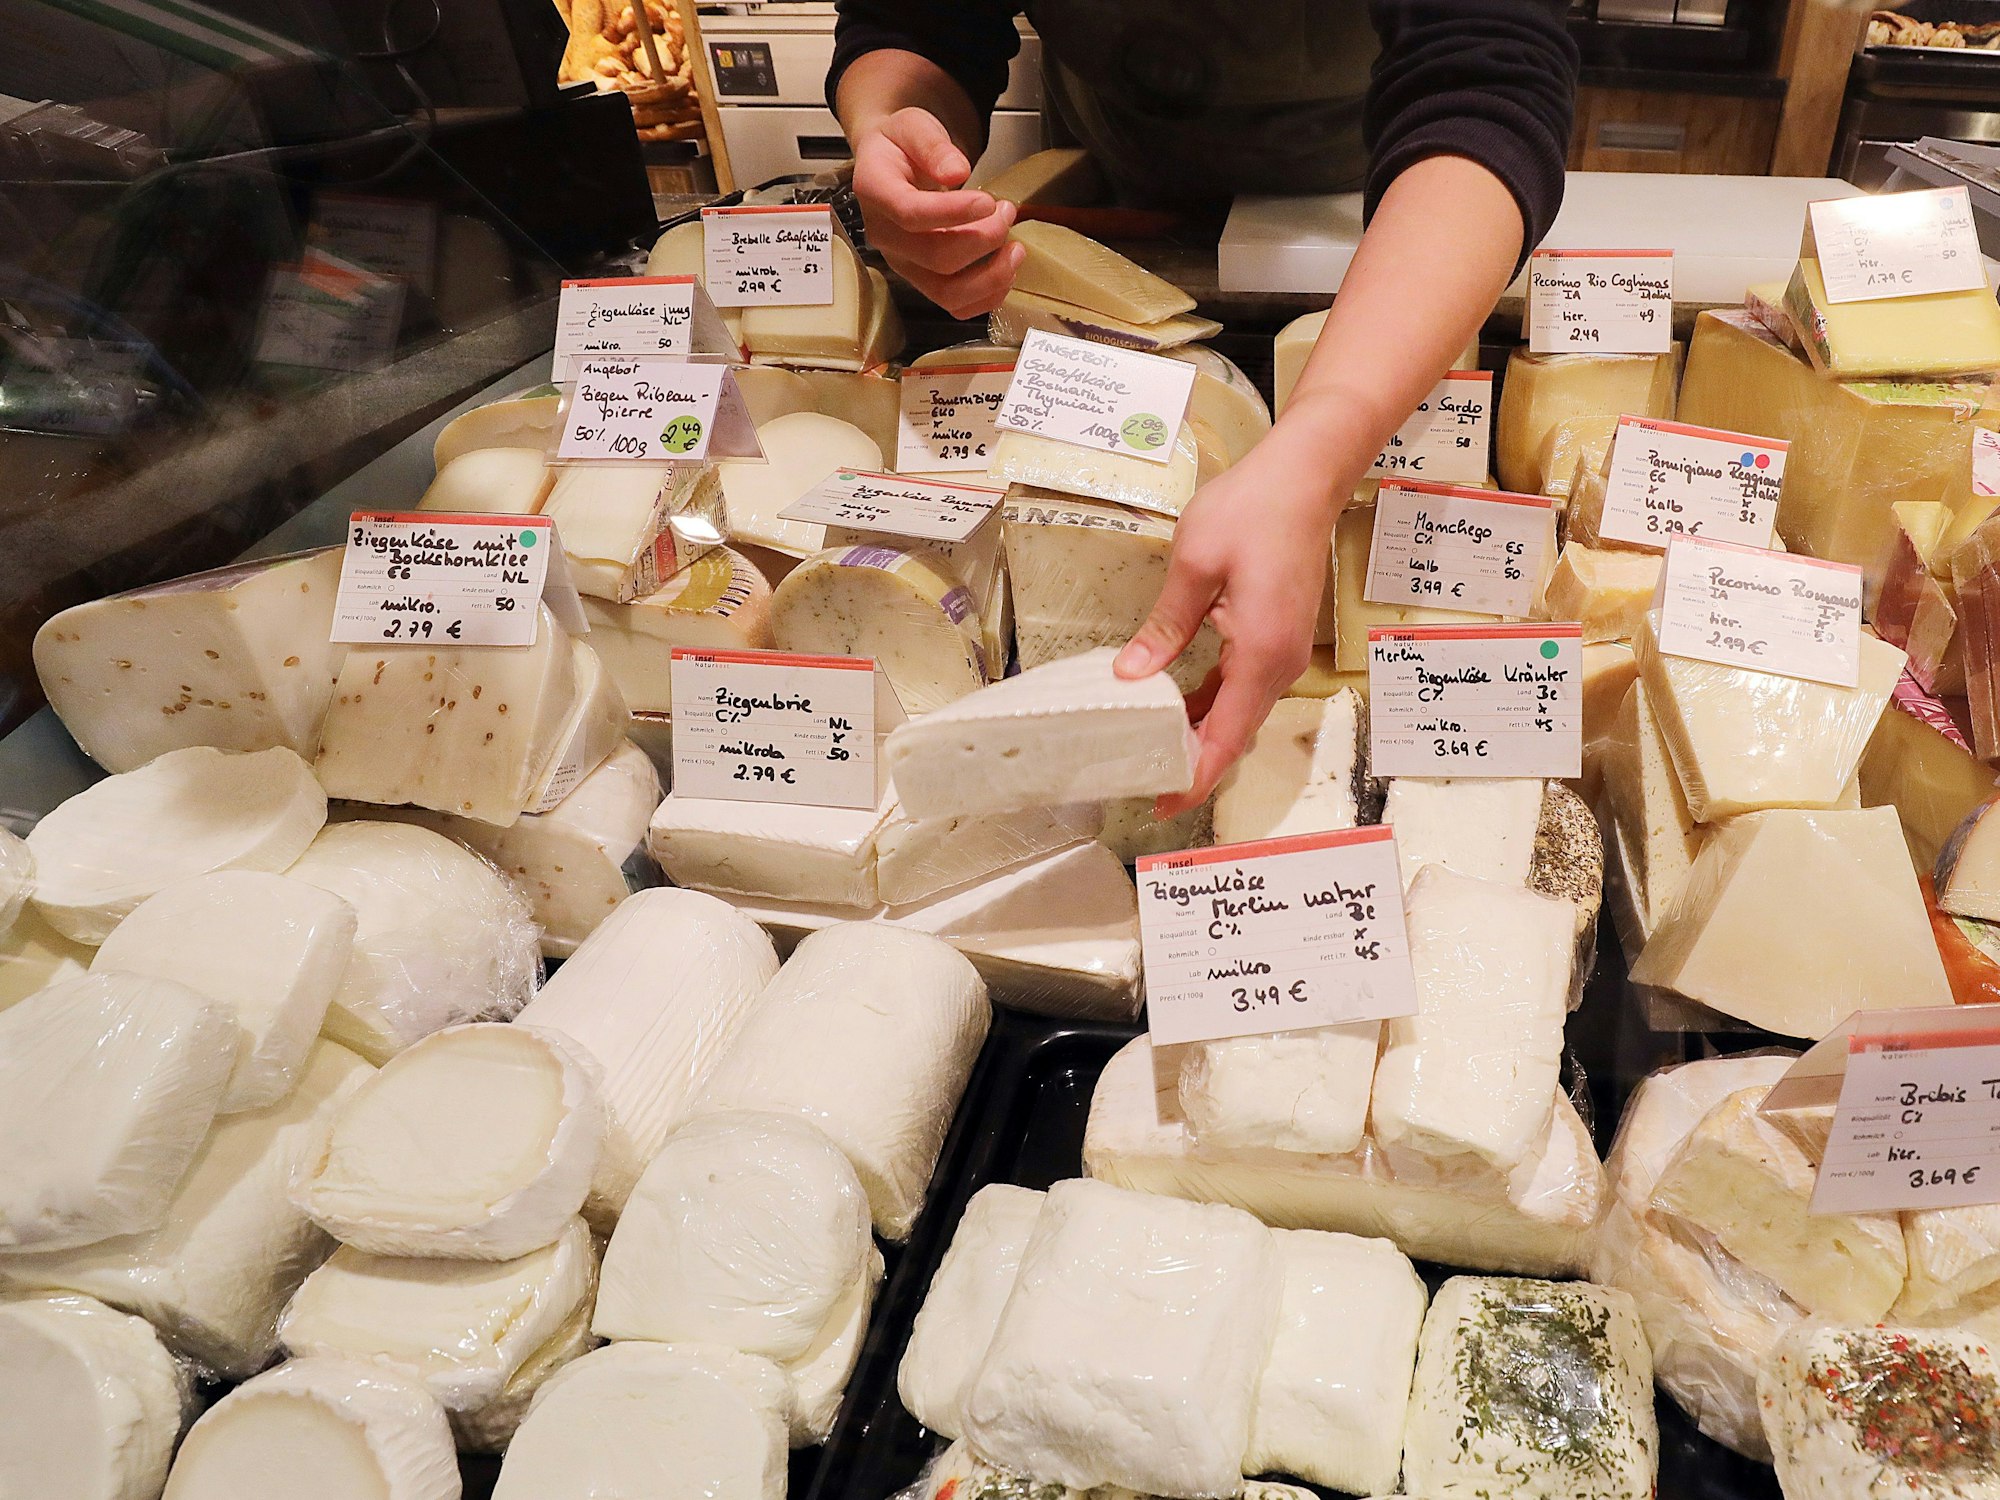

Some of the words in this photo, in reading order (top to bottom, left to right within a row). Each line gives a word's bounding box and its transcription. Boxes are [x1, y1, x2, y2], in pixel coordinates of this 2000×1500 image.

[806, 244, 821, 252] NL
[1942, 250, 1957, 260] 50
[803, 264, 818, 274] 53
[738, 280, 766, 293] 2.99
[770, 279, 782, 292] €
[1533, 272, 1582, 287] Pecorino
[1586, 272, 1607, 288] Rio
[1867, 273, 1896, 286] 1.79
[1901, 270, 1913, 284] €
[663, 315, 682, 326] NL
[1639, 309, 1654, 322] 49
[1569, 328, 1600, 342] 2.49
[658, 338, 672, 349] 50
[583, 363, 641, 379] Angebot
[1023, 358, 1131, 395] Schafskäse
[581, 385, 629, 408] Ziegen
[599, 404, 653, 421] pierre
[1438, 397, 1483, 413] Sardo
[683, 438, 698, 451] €
[1145, 432, 1166, 446] €
[940, 445, 969, 459] 2.79
[975, 443, 987, 456] €
[1374, 453, 1407, 469] 2.79
[1410, 456, 1426, 470] €
[1648, 449, 1723, 484] Parmigiano
[835, 511, 877, 522] 2.49
[951, 505, 974, 513] NL
[1645, 498, 1684, 513] Kalb
[1739, 510, 1756, 524] 32
[938, 514, 958, 523] 50
[1646, 515, 1684, 535] 3.29
[1688, 521, 1703, 535] €
[1414, 511, 1492, 543] Manchego
[354, 528, 459, 553] Ziegenkäse
[473, 534, 518, 551] mit
[1505, 541, 1524, 555] ES
[389, 549, 529, 567] Bockshornklee
[502, 569, 530, 584] NL
[1409, 557, 1439, 573] Kalb
[1504, 568, 1521, 580] 50
[1410, 577, 1442, 595] 3.99
[1451, 582, 1465, 597] €
[1708, 566, 1781, 596] Pecorino
[1789, 579, 1860, 609] Romano
[495, 597, 515, 612] 50
[383, 619, 433, 639] 2.79
[446, 619, 462, 639] €
[1706, 631, 1746, 652] 2.99
[1747, 640, 1768, 655] €
[1374, 647, 1425, 662] Merlin
[1504, 663, 1568, 682] Kräuter
[715, 687, 812, 717] Ziegenbrie
[829, 717, 852, 730] NL
[1534, 718, 1553, 732] 45
[826, 747, 850, 761] 50
[1433, 739, 1469, 756] 3.69
[1475, 740, 1489, 757] €
[733, 763, 775, 781] 2.79
[780, 767, 796, 784] €
[1146, 867, 1265, 906] Ziegenkäse
[1175, 909, 1196, 917] Name
[1212, 897, 1288, 919] Merlin
[1303, 882, 1376, 907] natur
[1159, 929, 1198, 940] Bioqualität
[1325, 911, 1343, 919] Land
[1168, 949, 1200, 960] Rohmilch
[1207, 959, 1272, 981] mikro
[1355, 942, 1380, 961] 45
[1231, 985, 1280, 1012] 3.49
[1288, 980, 1308, 1003] €
[1909, 1168, 1957, 1188] 3.69
[1962, 1166, 1981, 1184] €
